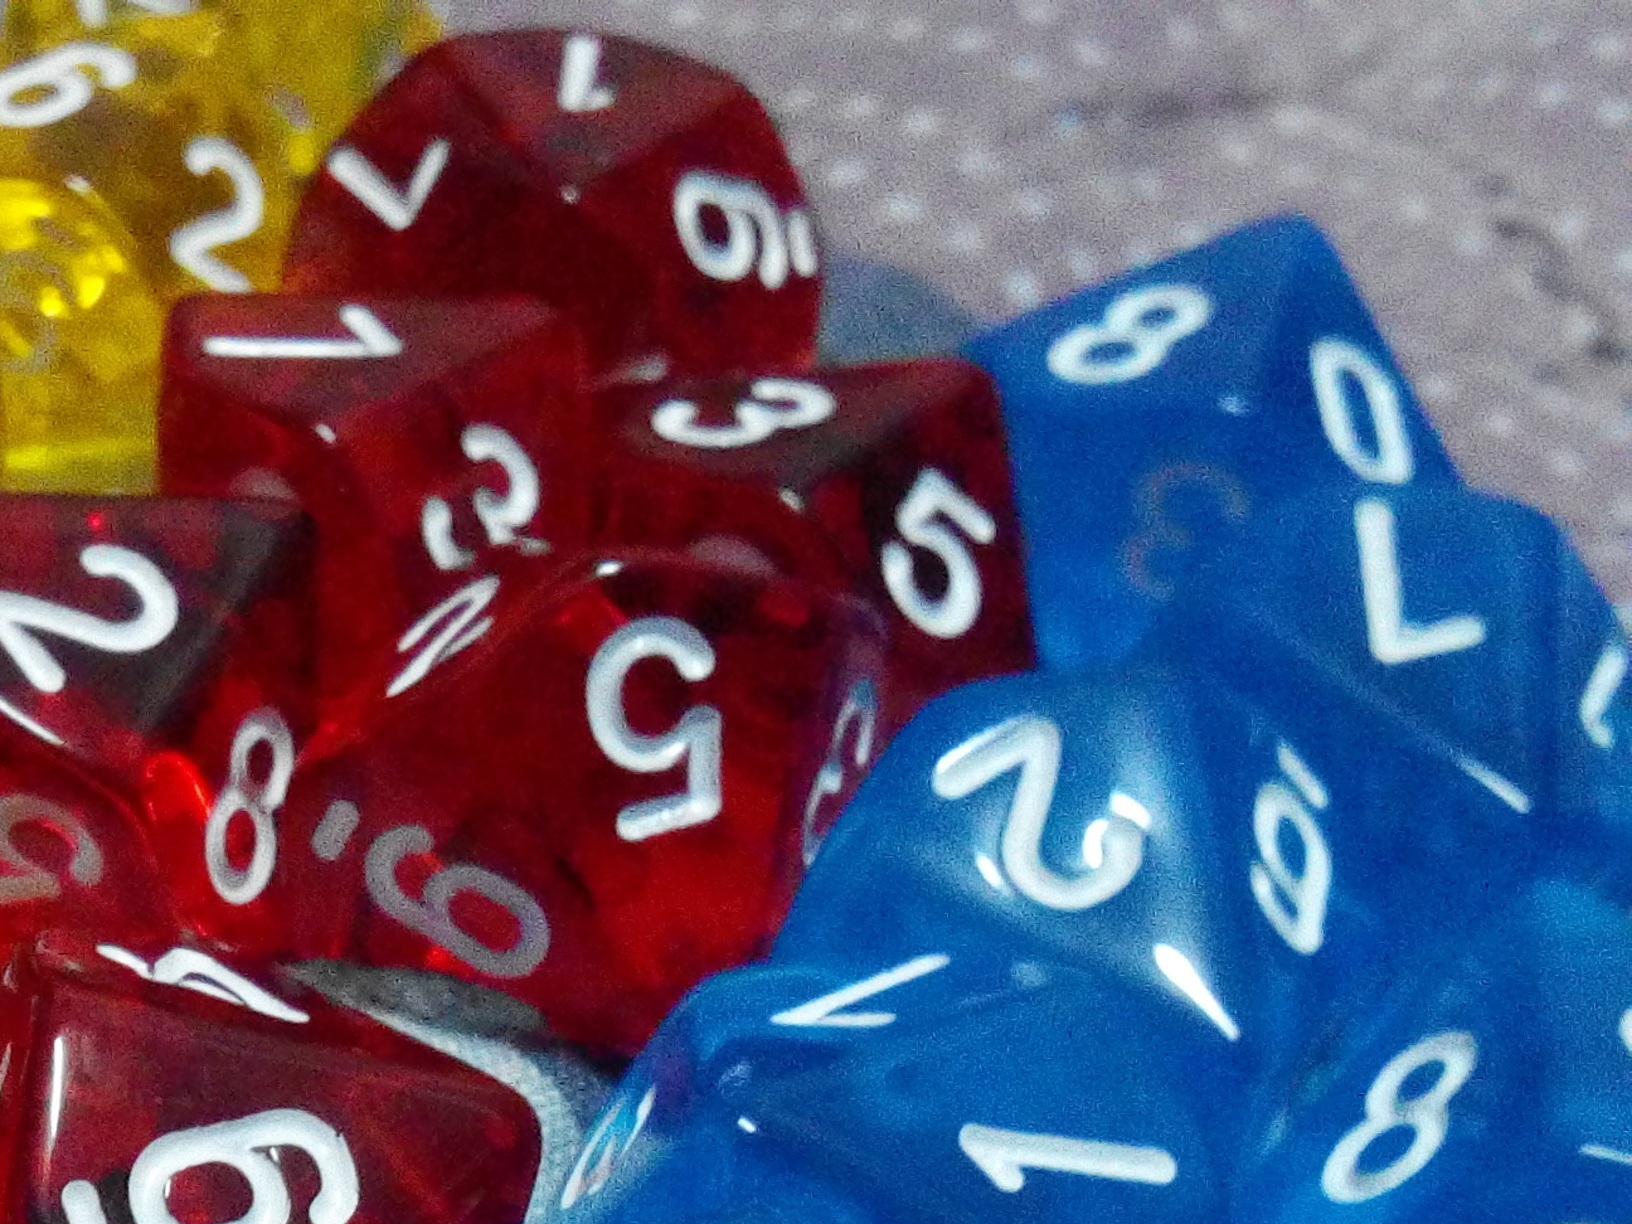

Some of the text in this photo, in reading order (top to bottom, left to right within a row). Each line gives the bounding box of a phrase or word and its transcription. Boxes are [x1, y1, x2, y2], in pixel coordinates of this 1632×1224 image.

[168, 135, 264, 294] 2
[652, 376, 836, 448] 3
[1046, 282, 1216, 386] 8
[1308, 334, 1414, 486] 0
[882, 467, 998, 638] 5
[204, 708, 296, 906] 8
[584, 613, 722, 843] 5
[931, 712, 1150, 912] 2
[1320, 1030, 1480, 1206] 8
